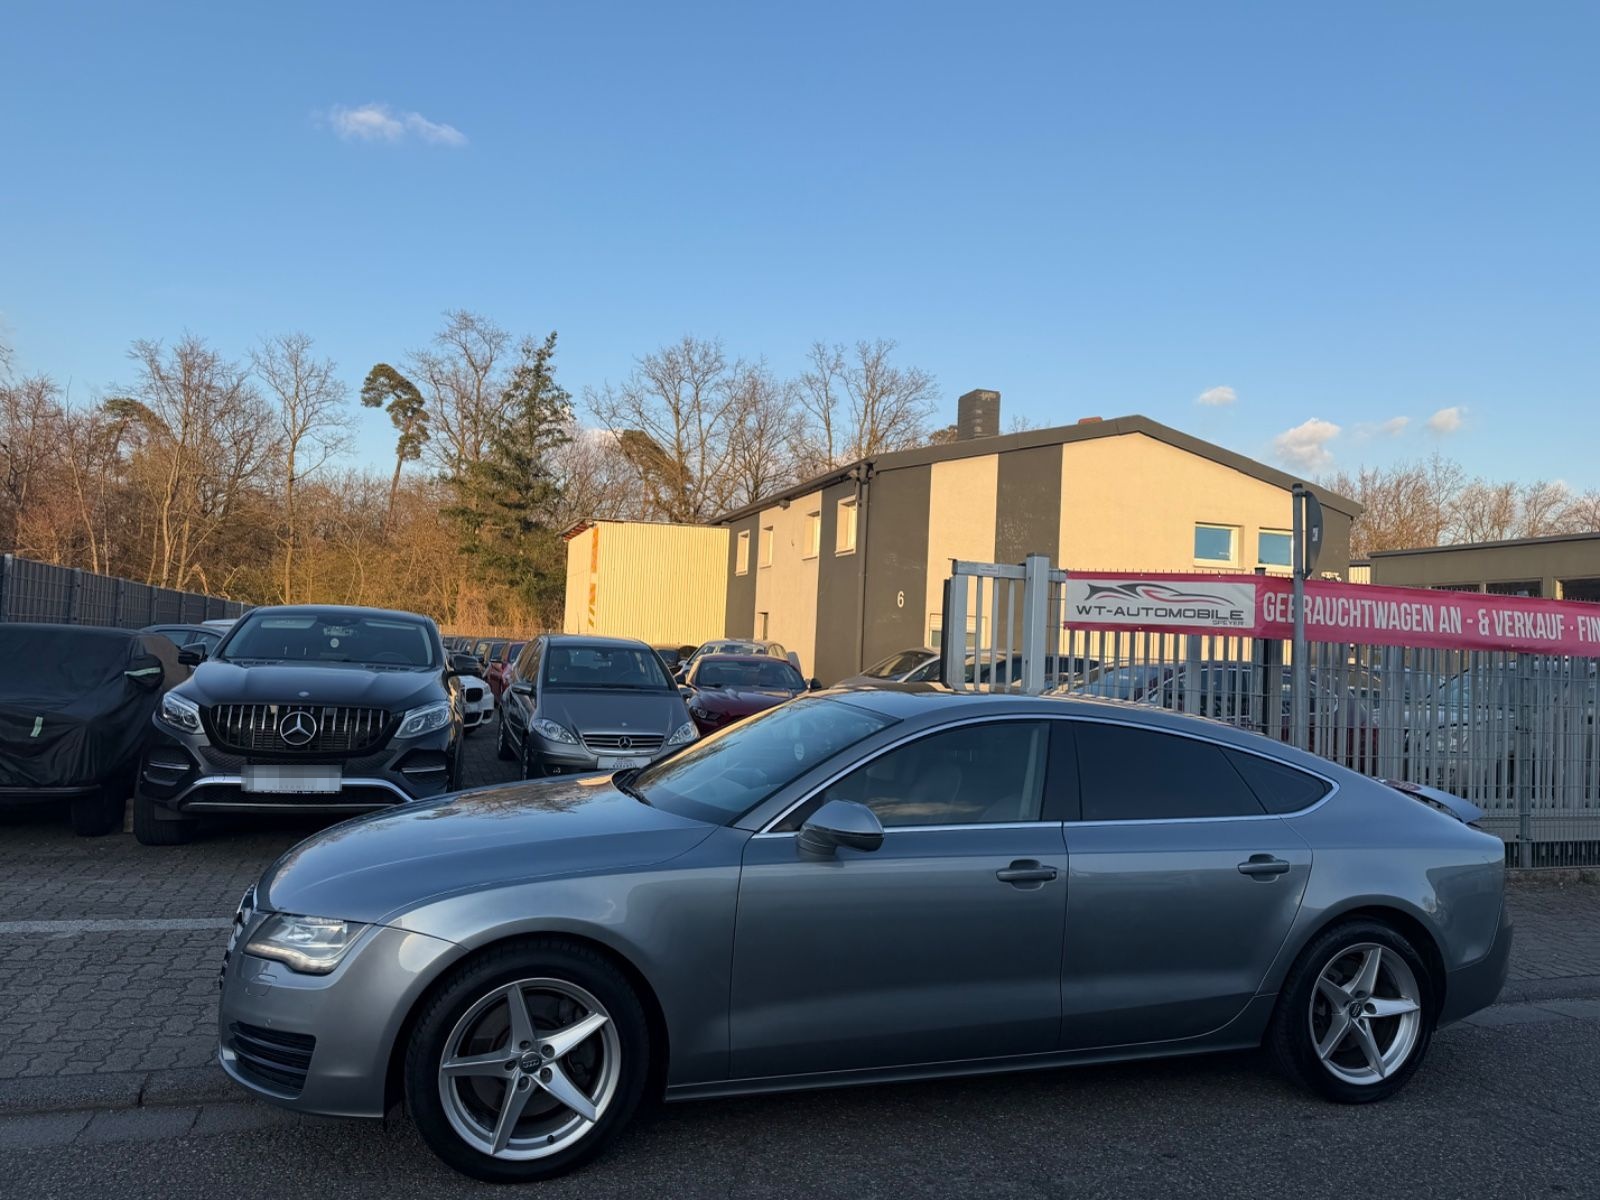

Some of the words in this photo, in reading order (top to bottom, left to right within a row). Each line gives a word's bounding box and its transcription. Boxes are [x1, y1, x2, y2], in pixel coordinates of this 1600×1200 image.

[897, 590, 904, 608] 6
[1076, 605, 1244, 620] WT-AUTOMOBILE
[1439, 606, 1462, 634] AN
[1478, 608, 1490, 636] &
[1492, 609, 1564, 640] VERKAUF
